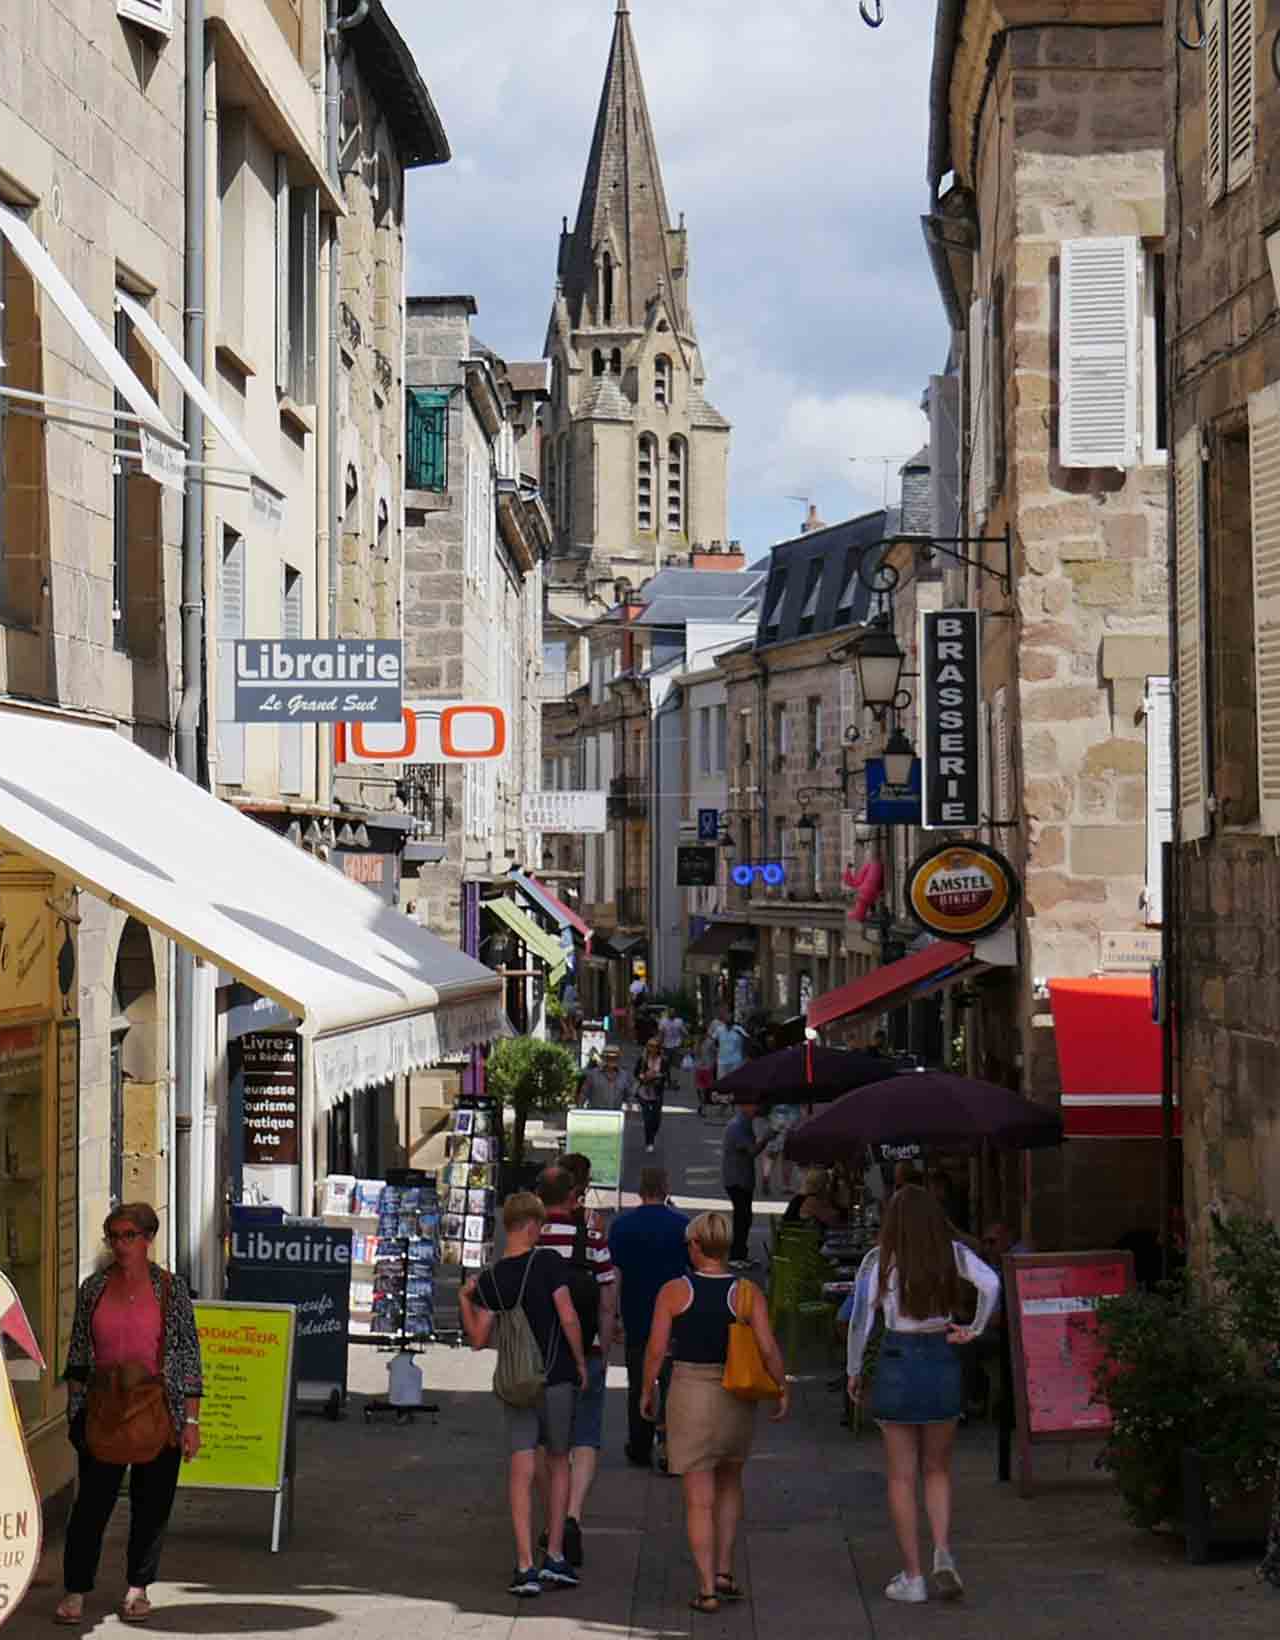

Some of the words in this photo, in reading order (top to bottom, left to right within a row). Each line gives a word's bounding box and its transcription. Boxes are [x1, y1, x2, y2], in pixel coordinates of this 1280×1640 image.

[237, 643, 400, 680] Librairie
[259, 693, 282, 712] Le
[287, 693, 338, 716] Grand
[342, 693, 378, 712] Sud
[936, 618, 966, 821] BRASSERIE
[928, 875, 989, 893] AMSTEL
[242, 1035, 294, 1051] Livres
[244, 1086, 296, 1097] eunesse
[242, 1100, 296, 1112] ourisme
[253, 1131, 281, 1145] Arts
[231, 1231, 350, 1262] Librairie
